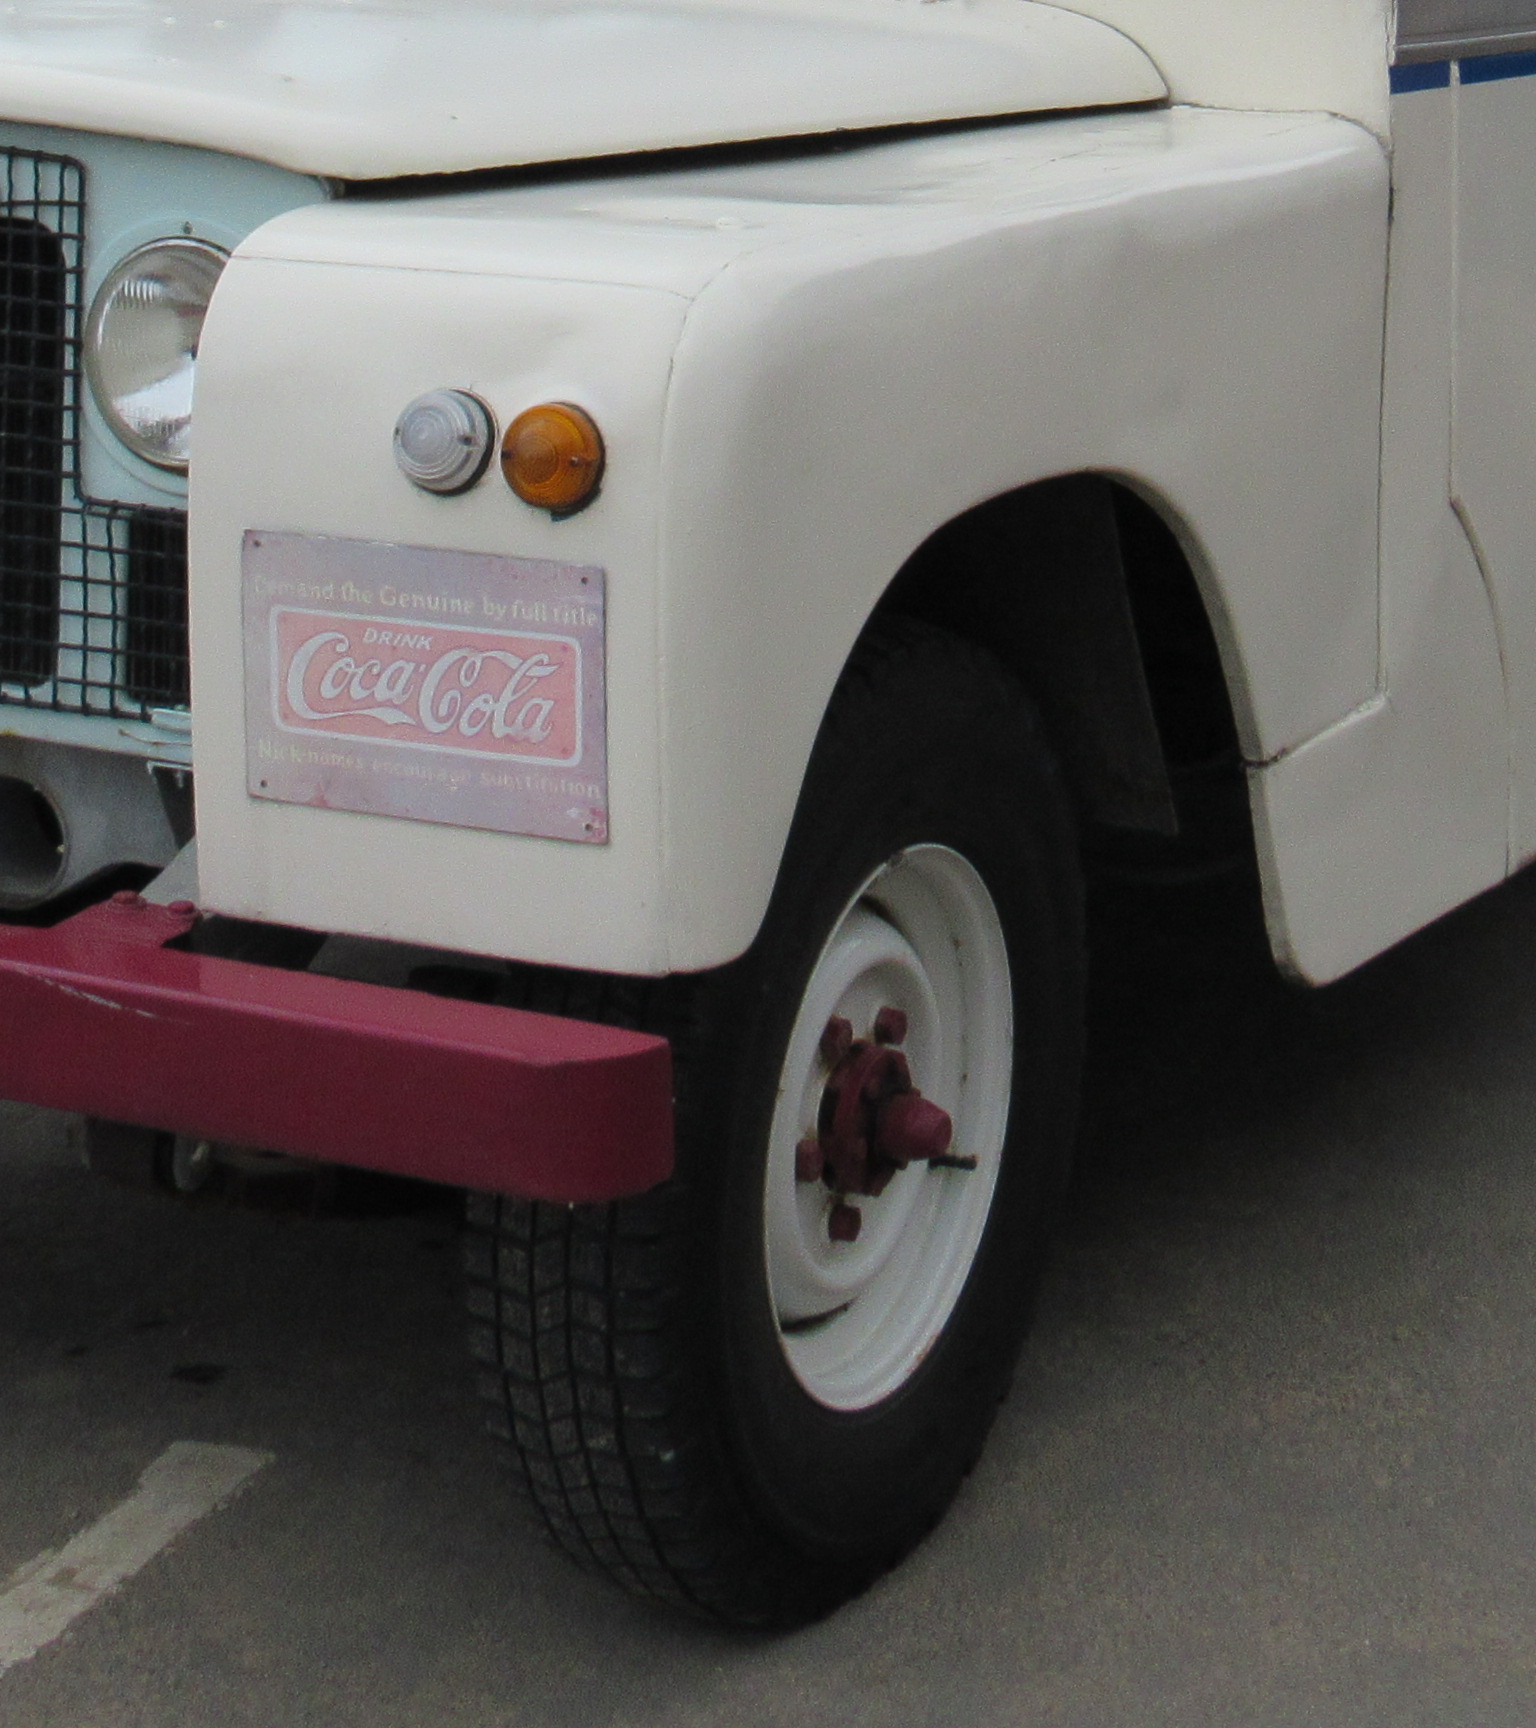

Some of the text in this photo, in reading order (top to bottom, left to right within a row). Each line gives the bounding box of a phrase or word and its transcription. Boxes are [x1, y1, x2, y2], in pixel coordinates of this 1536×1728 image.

[341, 580, 374, 604] the
[379, 586, 475, 615] Genuine
[482, 594, 506, 622] by
[510, 600, 548, 622] full
[552, 604, 599, 628] title
[363, 628, 434, 651] DRINK
